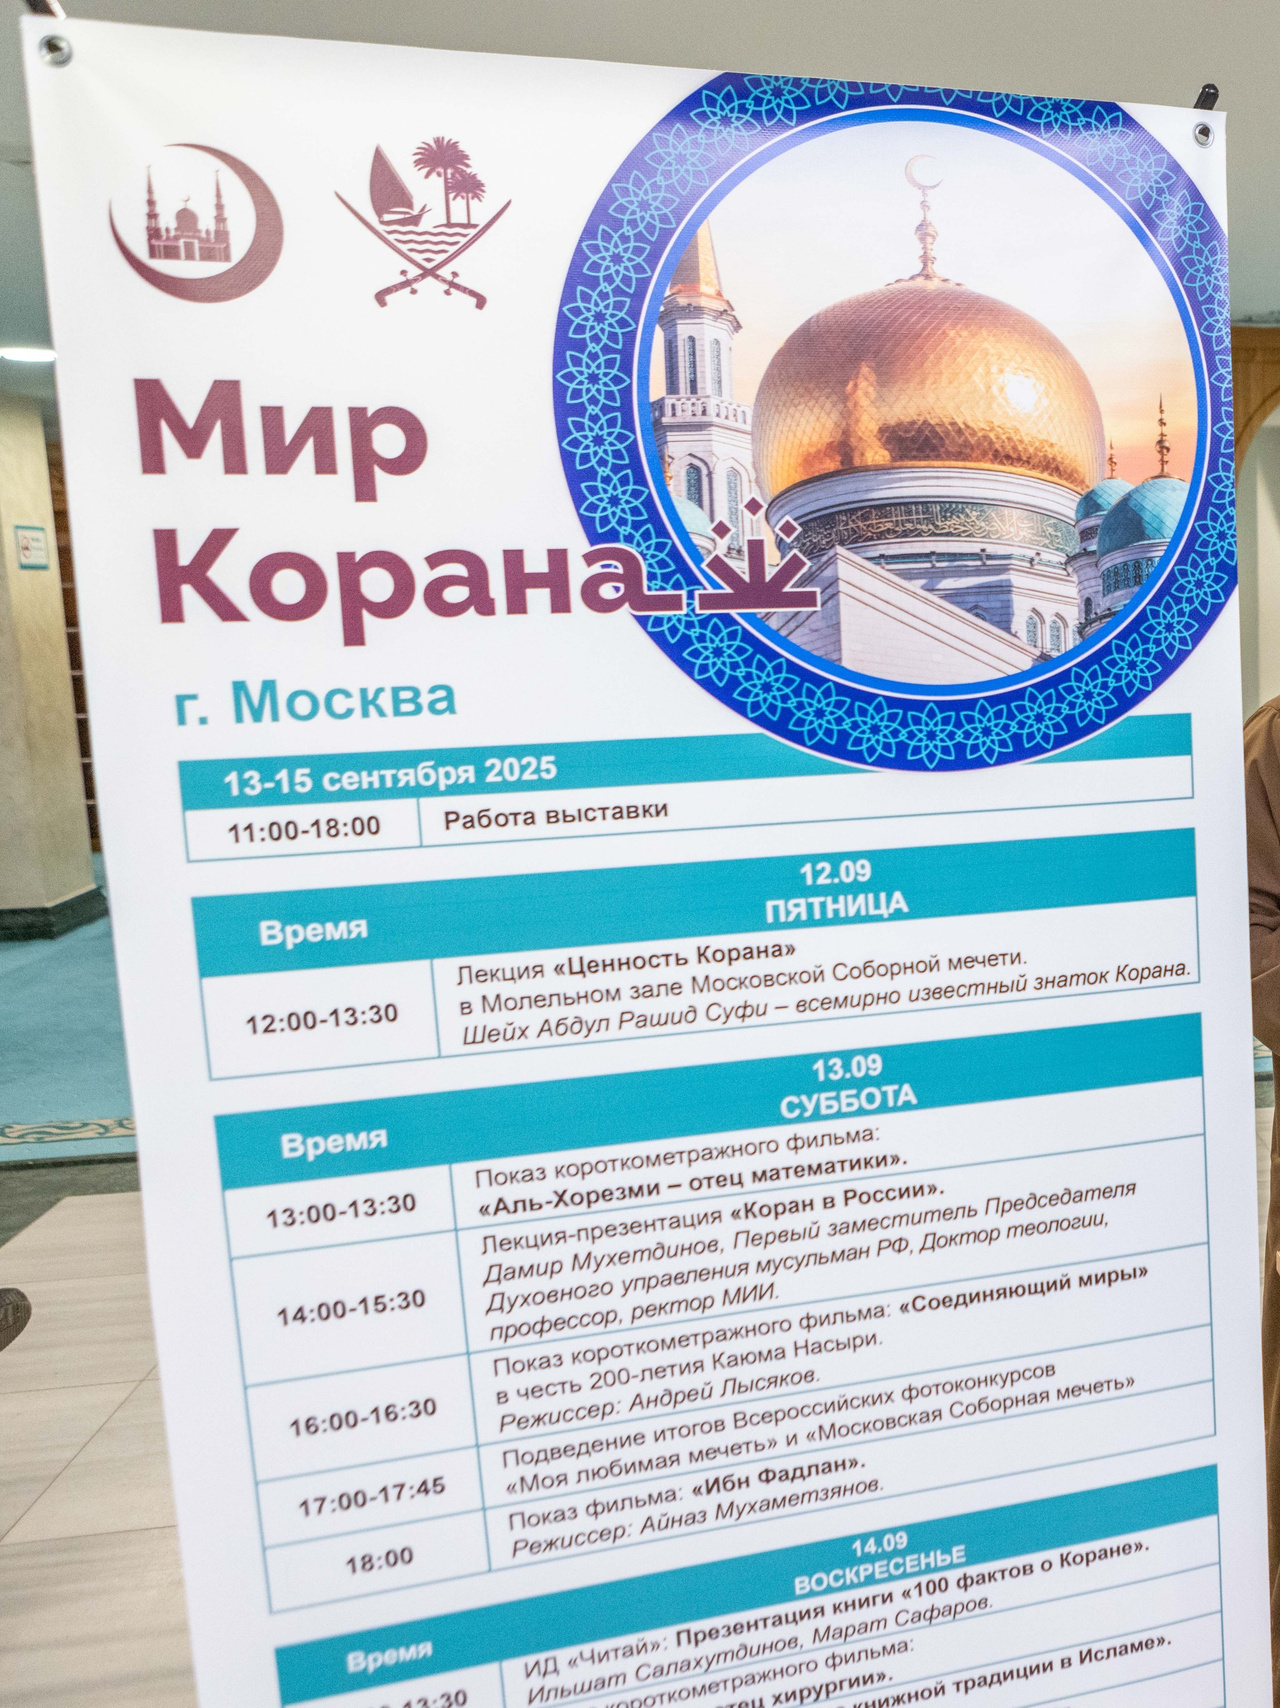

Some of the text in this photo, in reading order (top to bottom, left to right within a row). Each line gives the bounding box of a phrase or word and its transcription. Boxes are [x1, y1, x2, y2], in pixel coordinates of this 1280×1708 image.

[134, 379, 427, 502] Мир
[153, 528, 686, 647] Корана
[176, 680, 456, 725] г. Москва
[223, 755, 558, 797] 13-15 сентября 2025
[227, 815, 381, 845] 11:00-18:00
[443, 802, 669, 832] Работа выставки
[800, 858, 872, 886] 12.09
[765, 890, 909, 924] ПЯТНИЦА
[258, 918, 369, 951] Время
[456, 943, 797, 987] Лекция «Ценность Корана»
[459, 951, 1028, 1017] в Молельном зале Московской Соборной мечети.
[245, 1002, 399, 1036] 12:00-13:30
[462, 1021, 530, 1047] Шейх
[536, 1015, 611, 1039] Абдул
[617, 1004, 698, 1031] Рашид
[704, 999, 769, 1026] Суфи
[795, 989, 902, 1014] всемирно
[907, 973, 1028, 1003] известный
[1032, 970, 1111, 991] знаток
[1114, 962, 1191, 985] Корана.
[812, 1053, 883, 1082] 13.09
[780, 1083, 918, 1119] СУББОТА
[280, 1128, 388, 1162] Время
[475, 1127, 880, 1189] Показ короткометражного фильма:
[478, 1181, 661, 1217] «Аль-Хорезми
[688, 1171, 745, 1192] отец
[751, 1153, 908, 1185] математики».
[266, 1192, 417, 1229] 13:00-13:30
[481, 1183, 945, 1256] Лекция-презентация «Коран в России».
[482, 1182, 1137, 1288] Дамир Мухетдинов, Первый заместитель Председателя
[484, 1212, 1109, 1317] Духовного управления мусульман РФ, Доктор теологии,
[276, 1288, 426, 1327] 14:00-15:30
[489, 1281, 779, 1344] профессор, ректор МИИ.
[492, 1265, 1149, 1378] Показ короткометражного фильма: «Соединяющий миры»
[495, 1332, 883, 1406] в честь 200-летия Каюма Насыри.
[289, 1397, 438, 1438] 16:00-16:30
[499, 1369, 820, 1434] Режиссер: Андрей Лысяков.
[502, 1363, 1057, 1469] Подведение итогов Всероссийских фотоконкурсов
[506, 1376, 1136, 1495] «Моя любимая мечеть» и «Московская Соборная мечеть»
[298, 1475, 446, 1518] 17:00-17:45
[508, 1457, 866, 1532] Показ фильма: «Ибн Фадлан».
[511, 1478, 884, 1559] Режиссер: Айназ Мухаметзянов.
[345, 1546, 414, 1575] 18:00
[851, 1530, 908, 1558] 14.09
[794, 1544, 967, 1596] ВОСКРЕСЕНЬЕ
[524, 1541, 1150, 1680] ИД «Читай»: Презентация книги «100 фактов о Коране».
[346, 1641, 433, 1674] Время
[527, 1596, 993, 1706] Ильшат Салахутдинов, Марат Сафаров.
[824, 1638, 914, 1672] фильма:
[951, 1659, 1054, 1696] традиции
[1060, 1656, 1073, 1670] в
[1078, 1635, 1172, 1666] Исламе».
[771, 1671, 894, 1707] хирургии».
